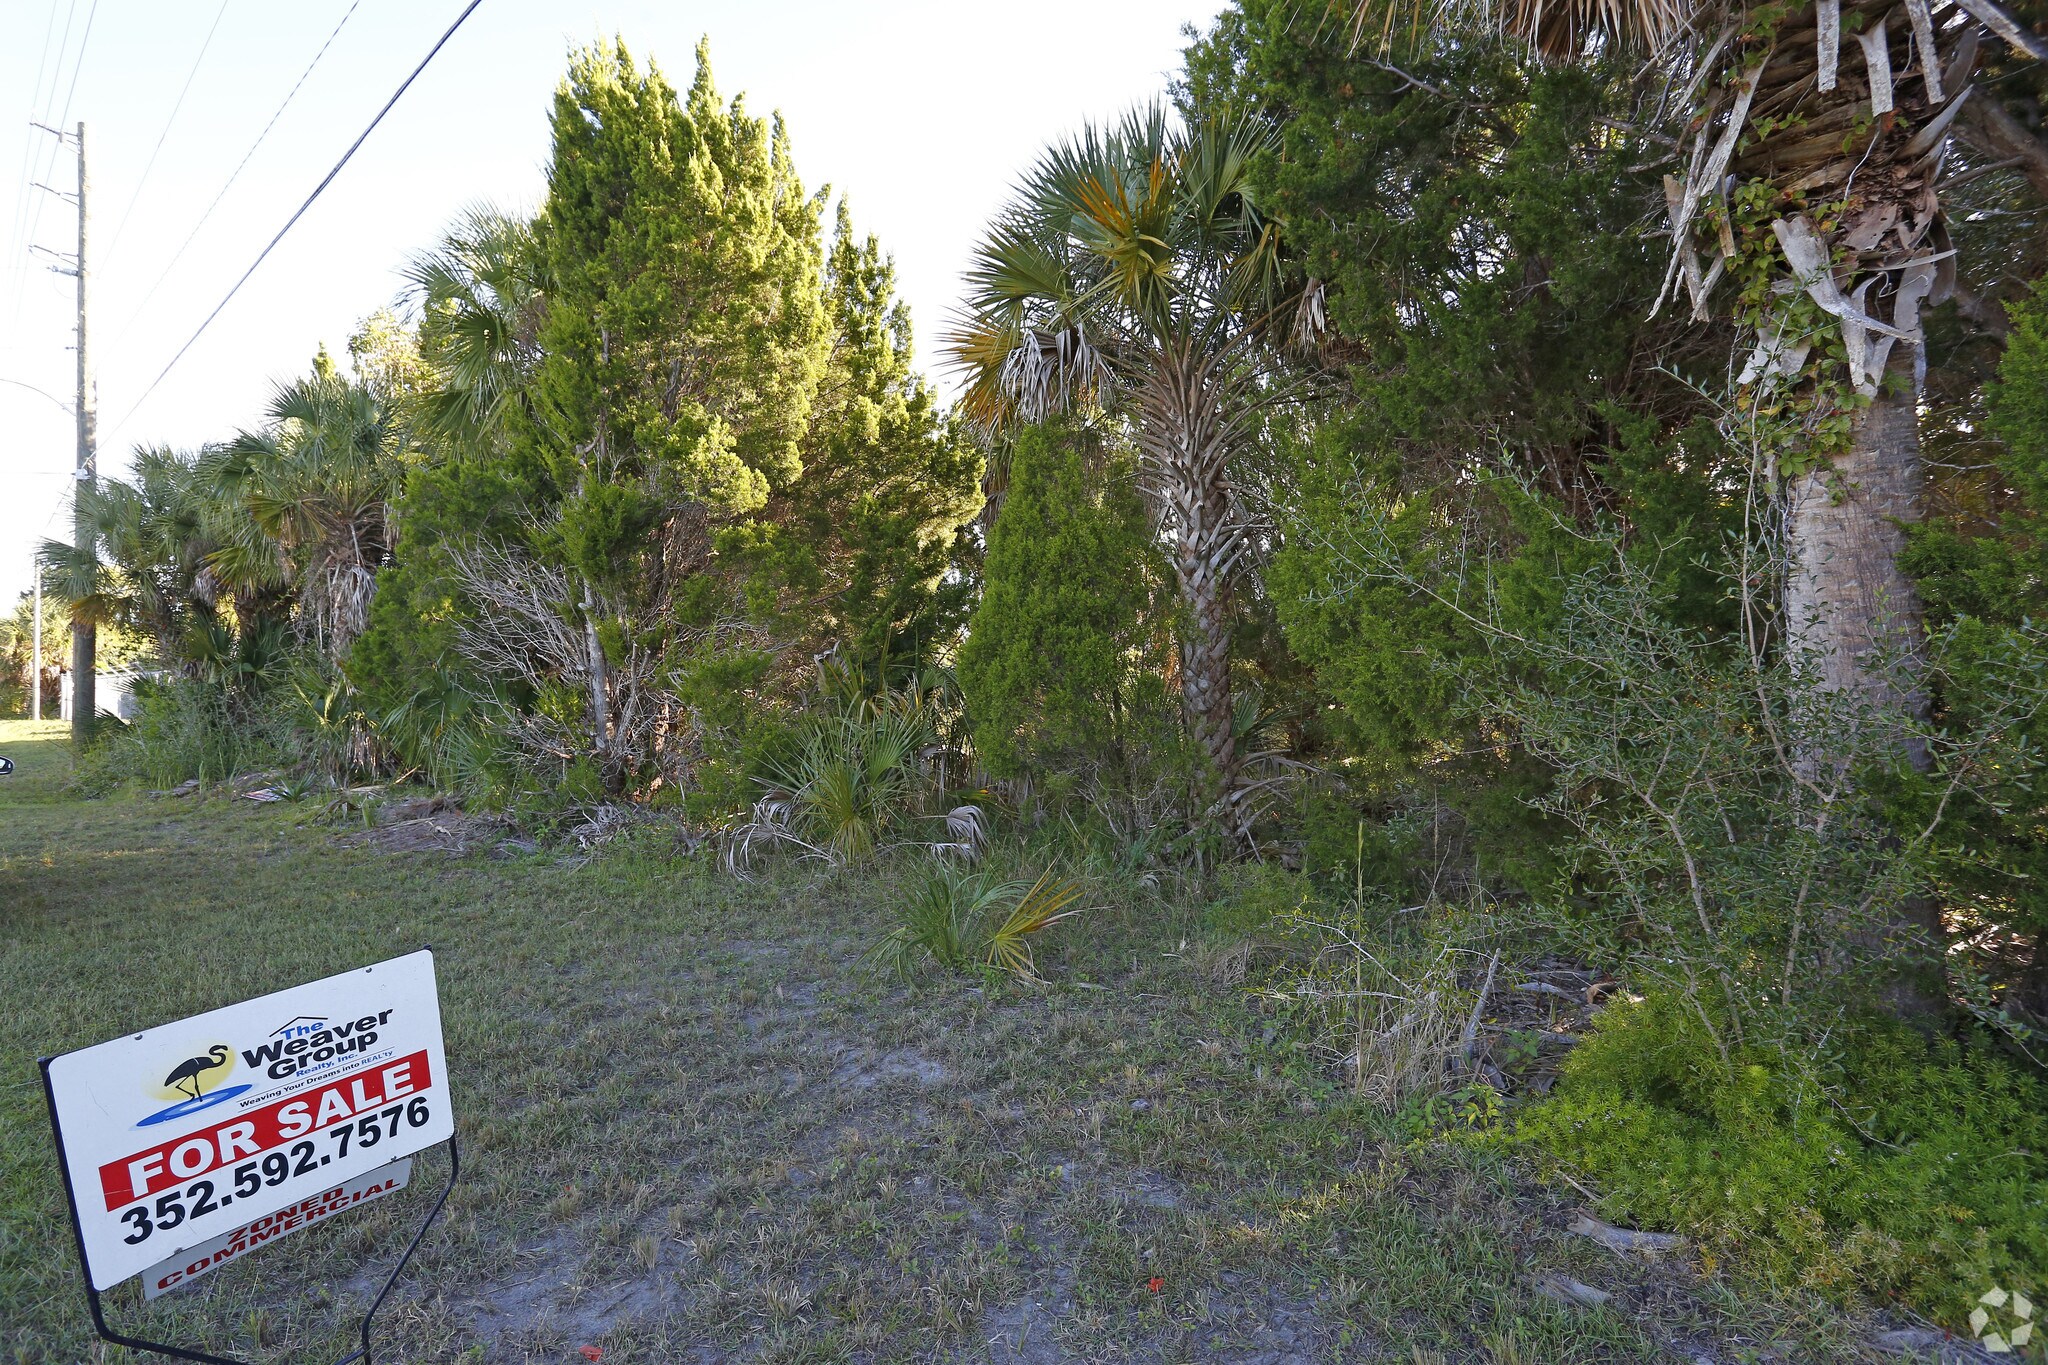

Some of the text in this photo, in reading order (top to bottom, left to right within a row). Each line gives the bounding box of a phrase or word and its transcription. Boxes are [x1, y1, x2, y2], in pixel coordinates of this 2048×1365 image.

[241, 1009, 394, 1069] Weaver
[267, 1031, 379, 1080] Group
[280, 1022, 324, 1040] The
[240, 1050, 394, 1108] Weaving Your Dreams into REAL'ty
[296, 1053, 359, 1078] Realty, Inc.
[127, 1061, 416, 1198] FOR SALE
[120, 1096, 430, 1246] 352.592.7576
[157, 1178, 401, 1290] COMMERCIAL
[227, 1187, 344, 1245] ZONED
